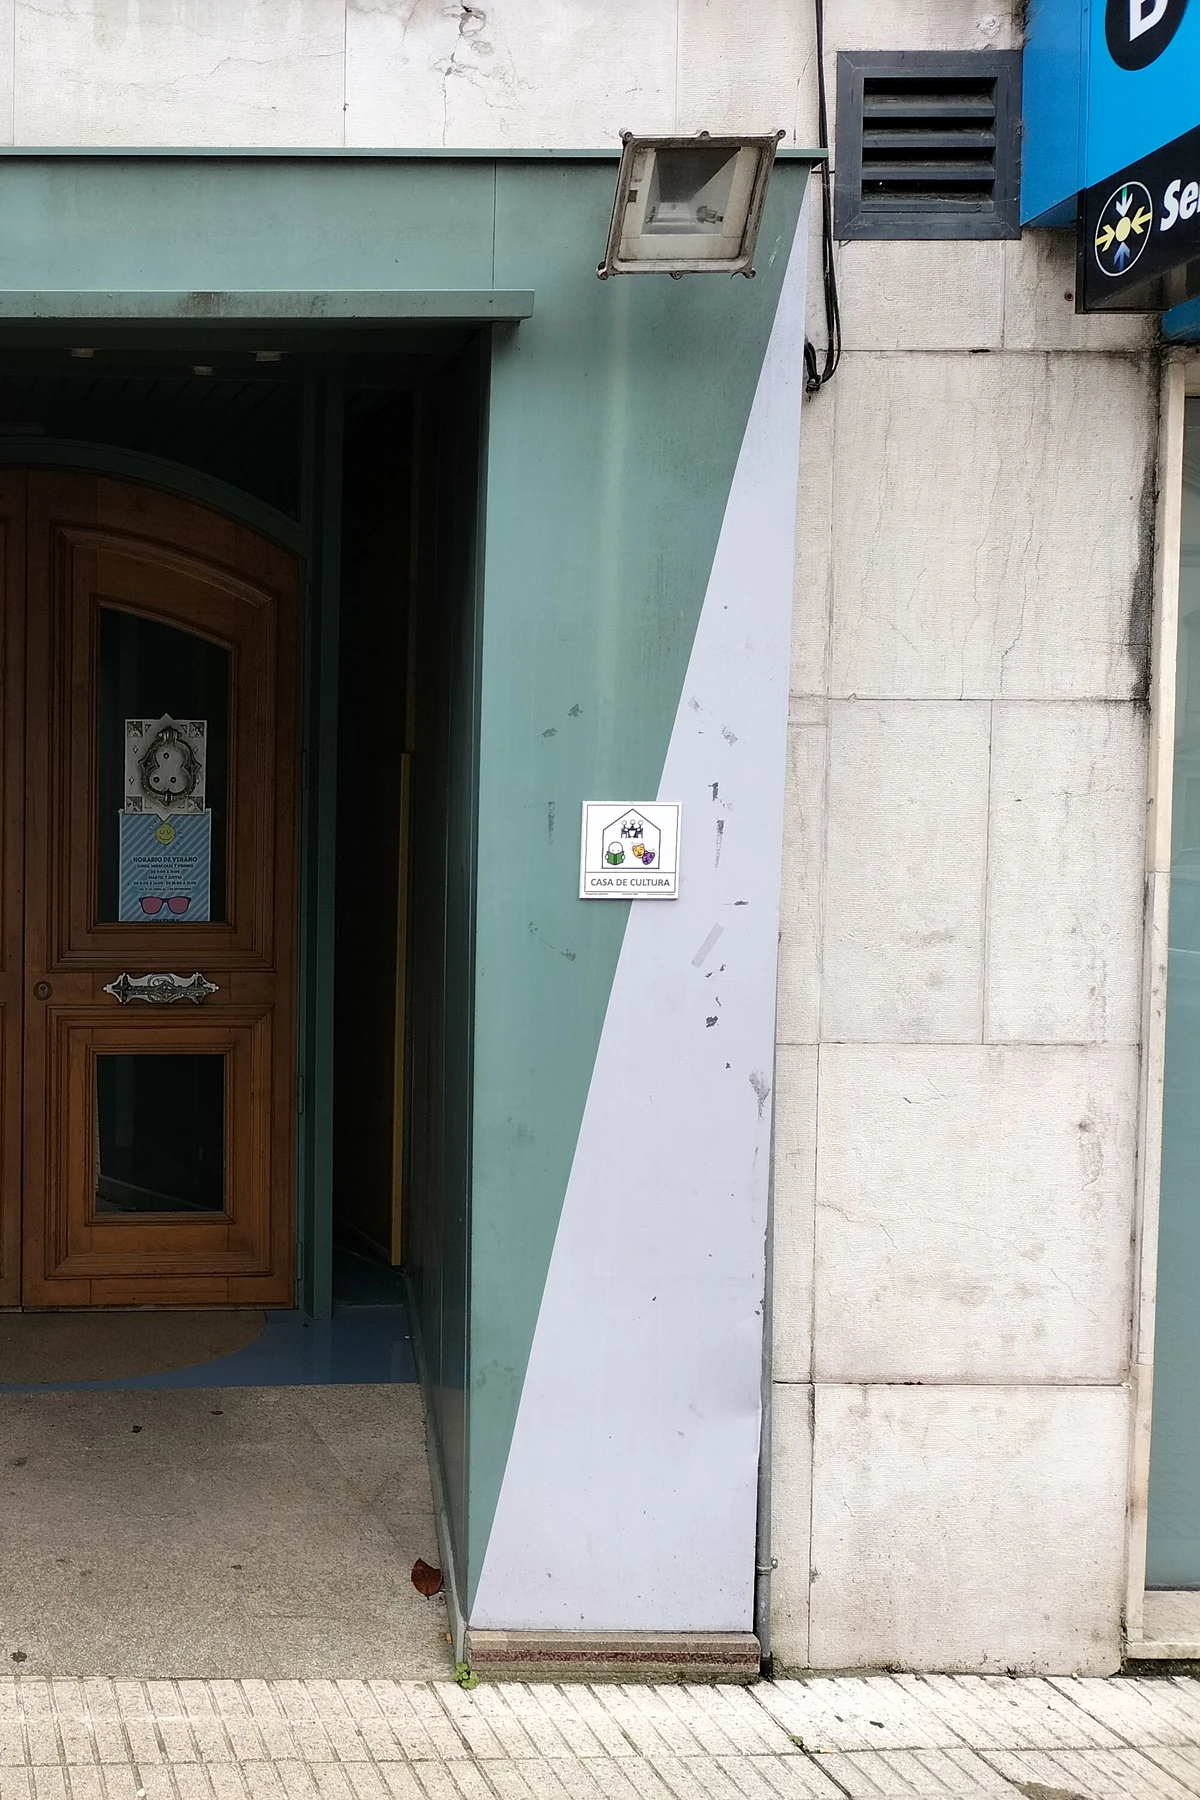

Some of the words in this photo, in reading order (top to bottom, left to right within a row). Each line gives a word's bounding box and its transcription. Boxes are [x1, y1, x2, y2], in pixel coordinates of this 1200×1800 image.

[1160, 179, 1200, 231] Se
[590, 878, 614, 887] CASA
[616, 878, 628, 887] DE
[630, 878, 670, 887] CULTURA
